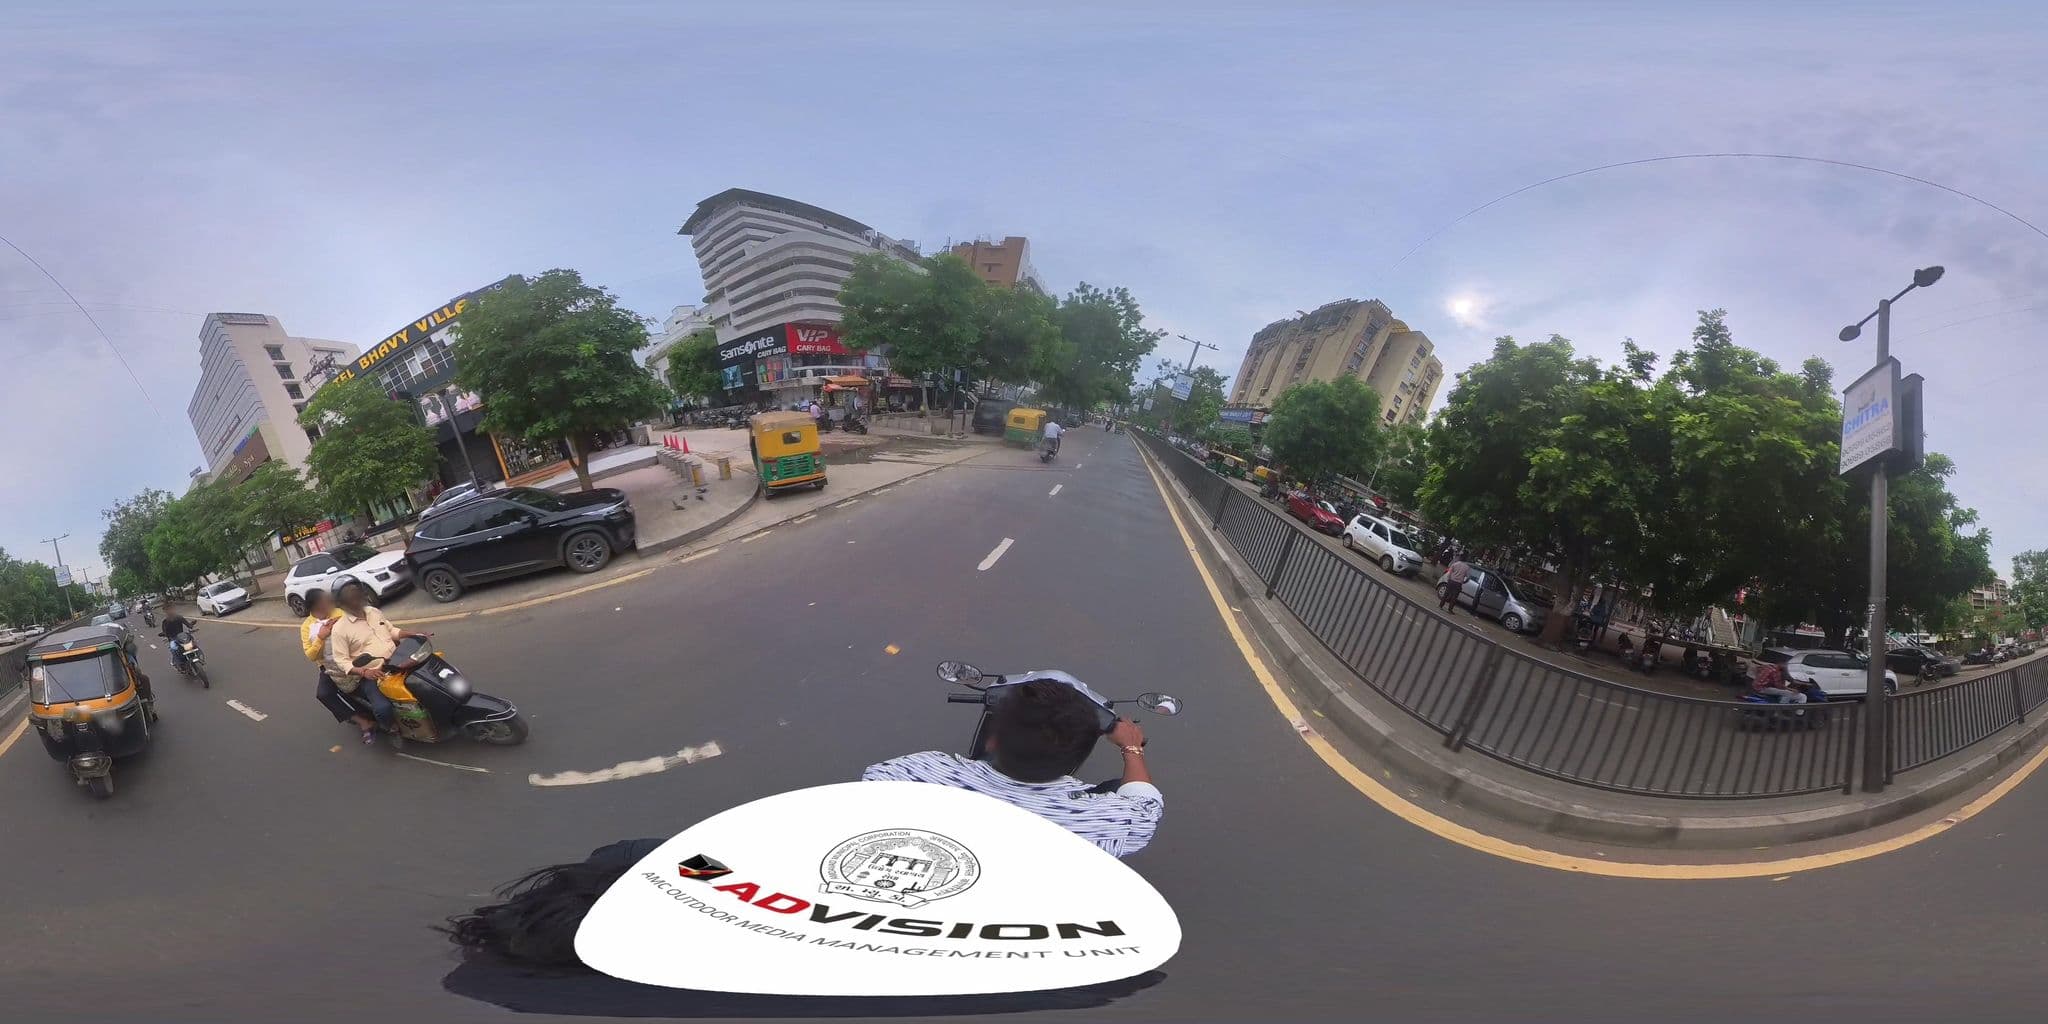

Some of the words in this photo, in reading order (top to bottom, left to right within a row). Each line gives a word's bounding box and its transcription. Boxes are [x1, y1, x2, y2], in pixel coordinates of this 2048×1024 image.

[358, 329, 409, 370] BHAVY
[720, 336, 775, 361] Samsonite
[757, 349, 773, 359] CARY
[796, 344, 815, 352] CARY
